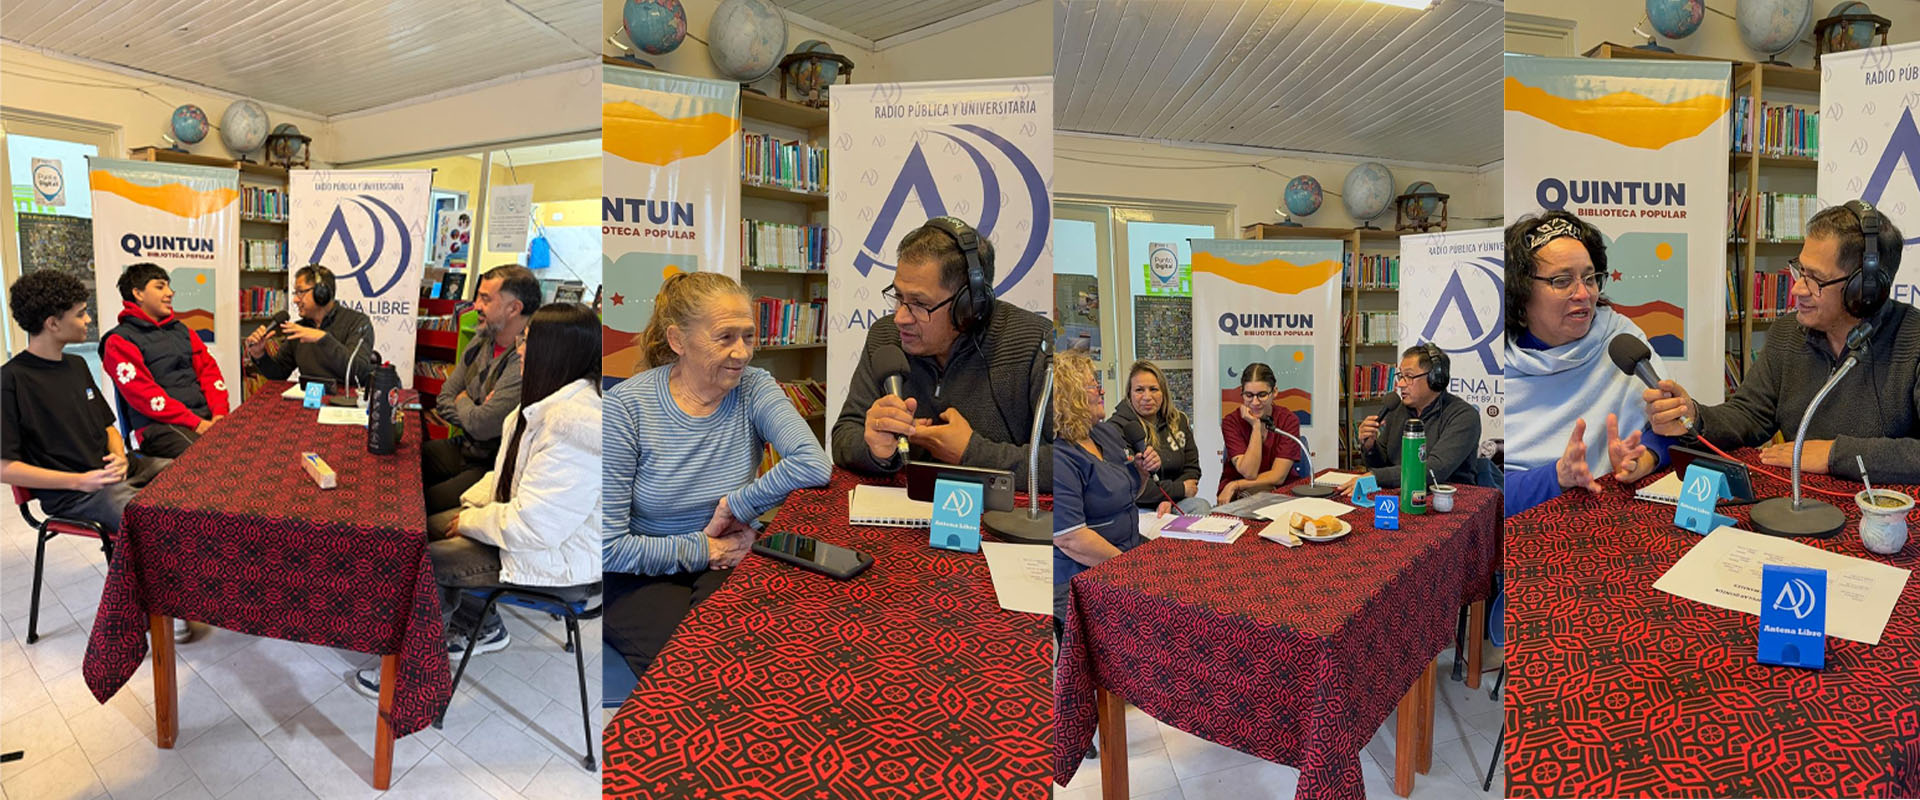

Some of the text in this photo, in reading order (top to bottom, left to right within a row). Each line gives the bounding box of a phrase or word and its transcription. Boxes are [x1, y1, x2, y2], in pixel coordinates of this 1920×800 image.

[1865, 68, 1895, 86] RADIO
[874, 100, 1036, 119] RADIO PÚBLICA Y UNIVERSITARIA
[1536, 177, 1686, 212] QUINTUN
[1578, 208, 1687, 219] BIBLIOTECA POPULAR
[645, 228, 696, 240] POPULAR
[121, 233, 214, 257] QUINTUN
[369, 300, 410, 315] LIBRE
[1218, 312, 1313, 336] QUINTUN
[1466, 394, 1479, 403] FM
[1763, 624, 1823, 638] Antena Libre
